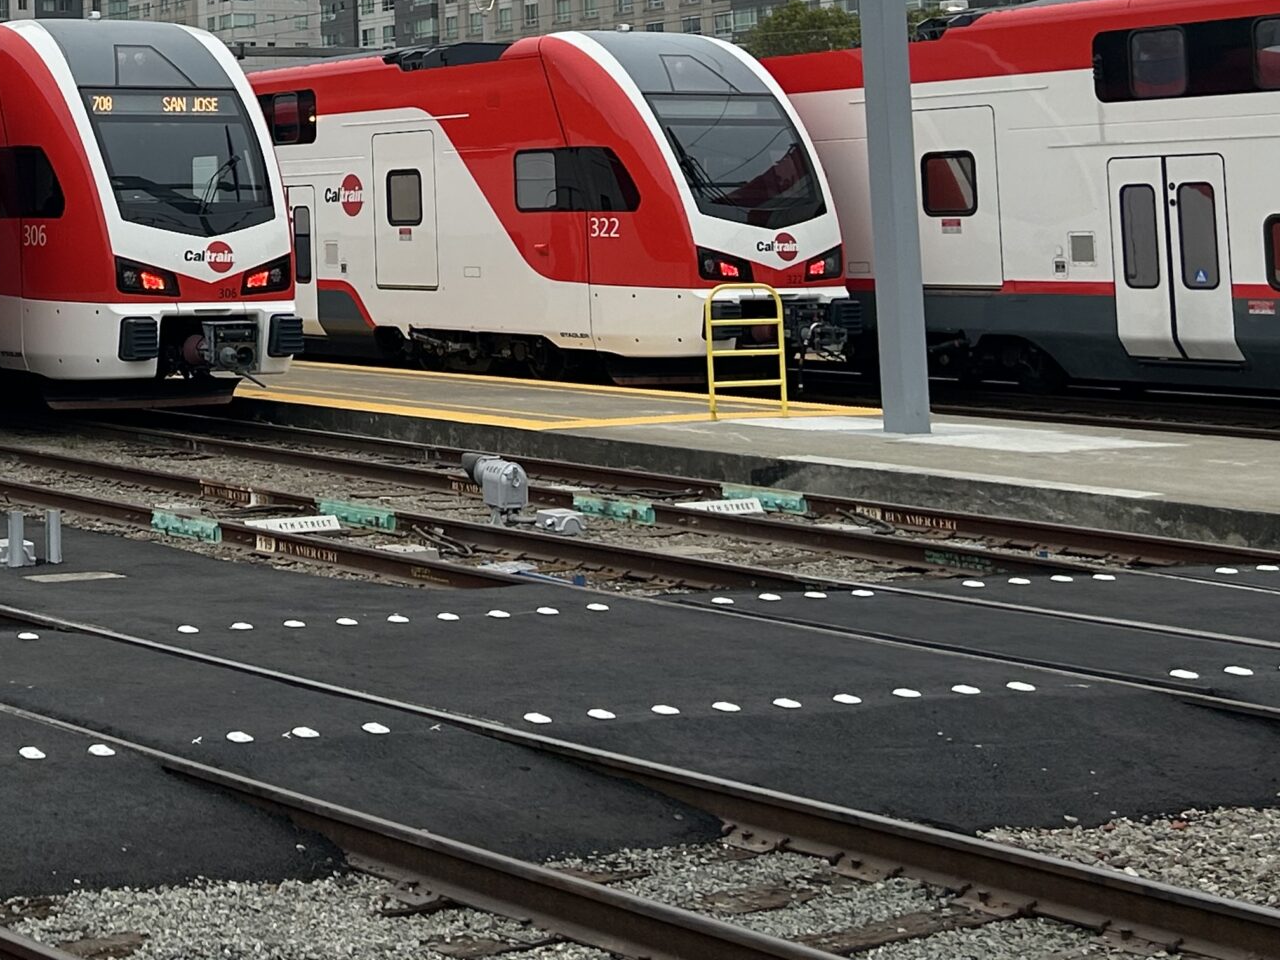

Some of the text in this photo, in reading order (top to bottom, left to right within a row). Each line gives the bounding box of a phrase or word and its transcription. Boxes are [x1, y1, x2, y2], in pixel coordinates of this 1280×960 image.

[93, 96, 219, 112] 708 SAN JOSE
[324, 186, 364, 203] Caltrain
[590, 217, 620, 238] 322
[23, 224, 47, 247] 306
[756, 240, 798, 252] Caltrain
[184, 249, 236, 262] Caltrain
[217, 287, 238, 299] 306
[725, 502, 756, 512] STREET
[884, 511, 902, 522] BUY
[278, 521, 298, 530] 4TH
[299, 519, 332, 529] STREET
[278, 541, 293, 553] BUY
